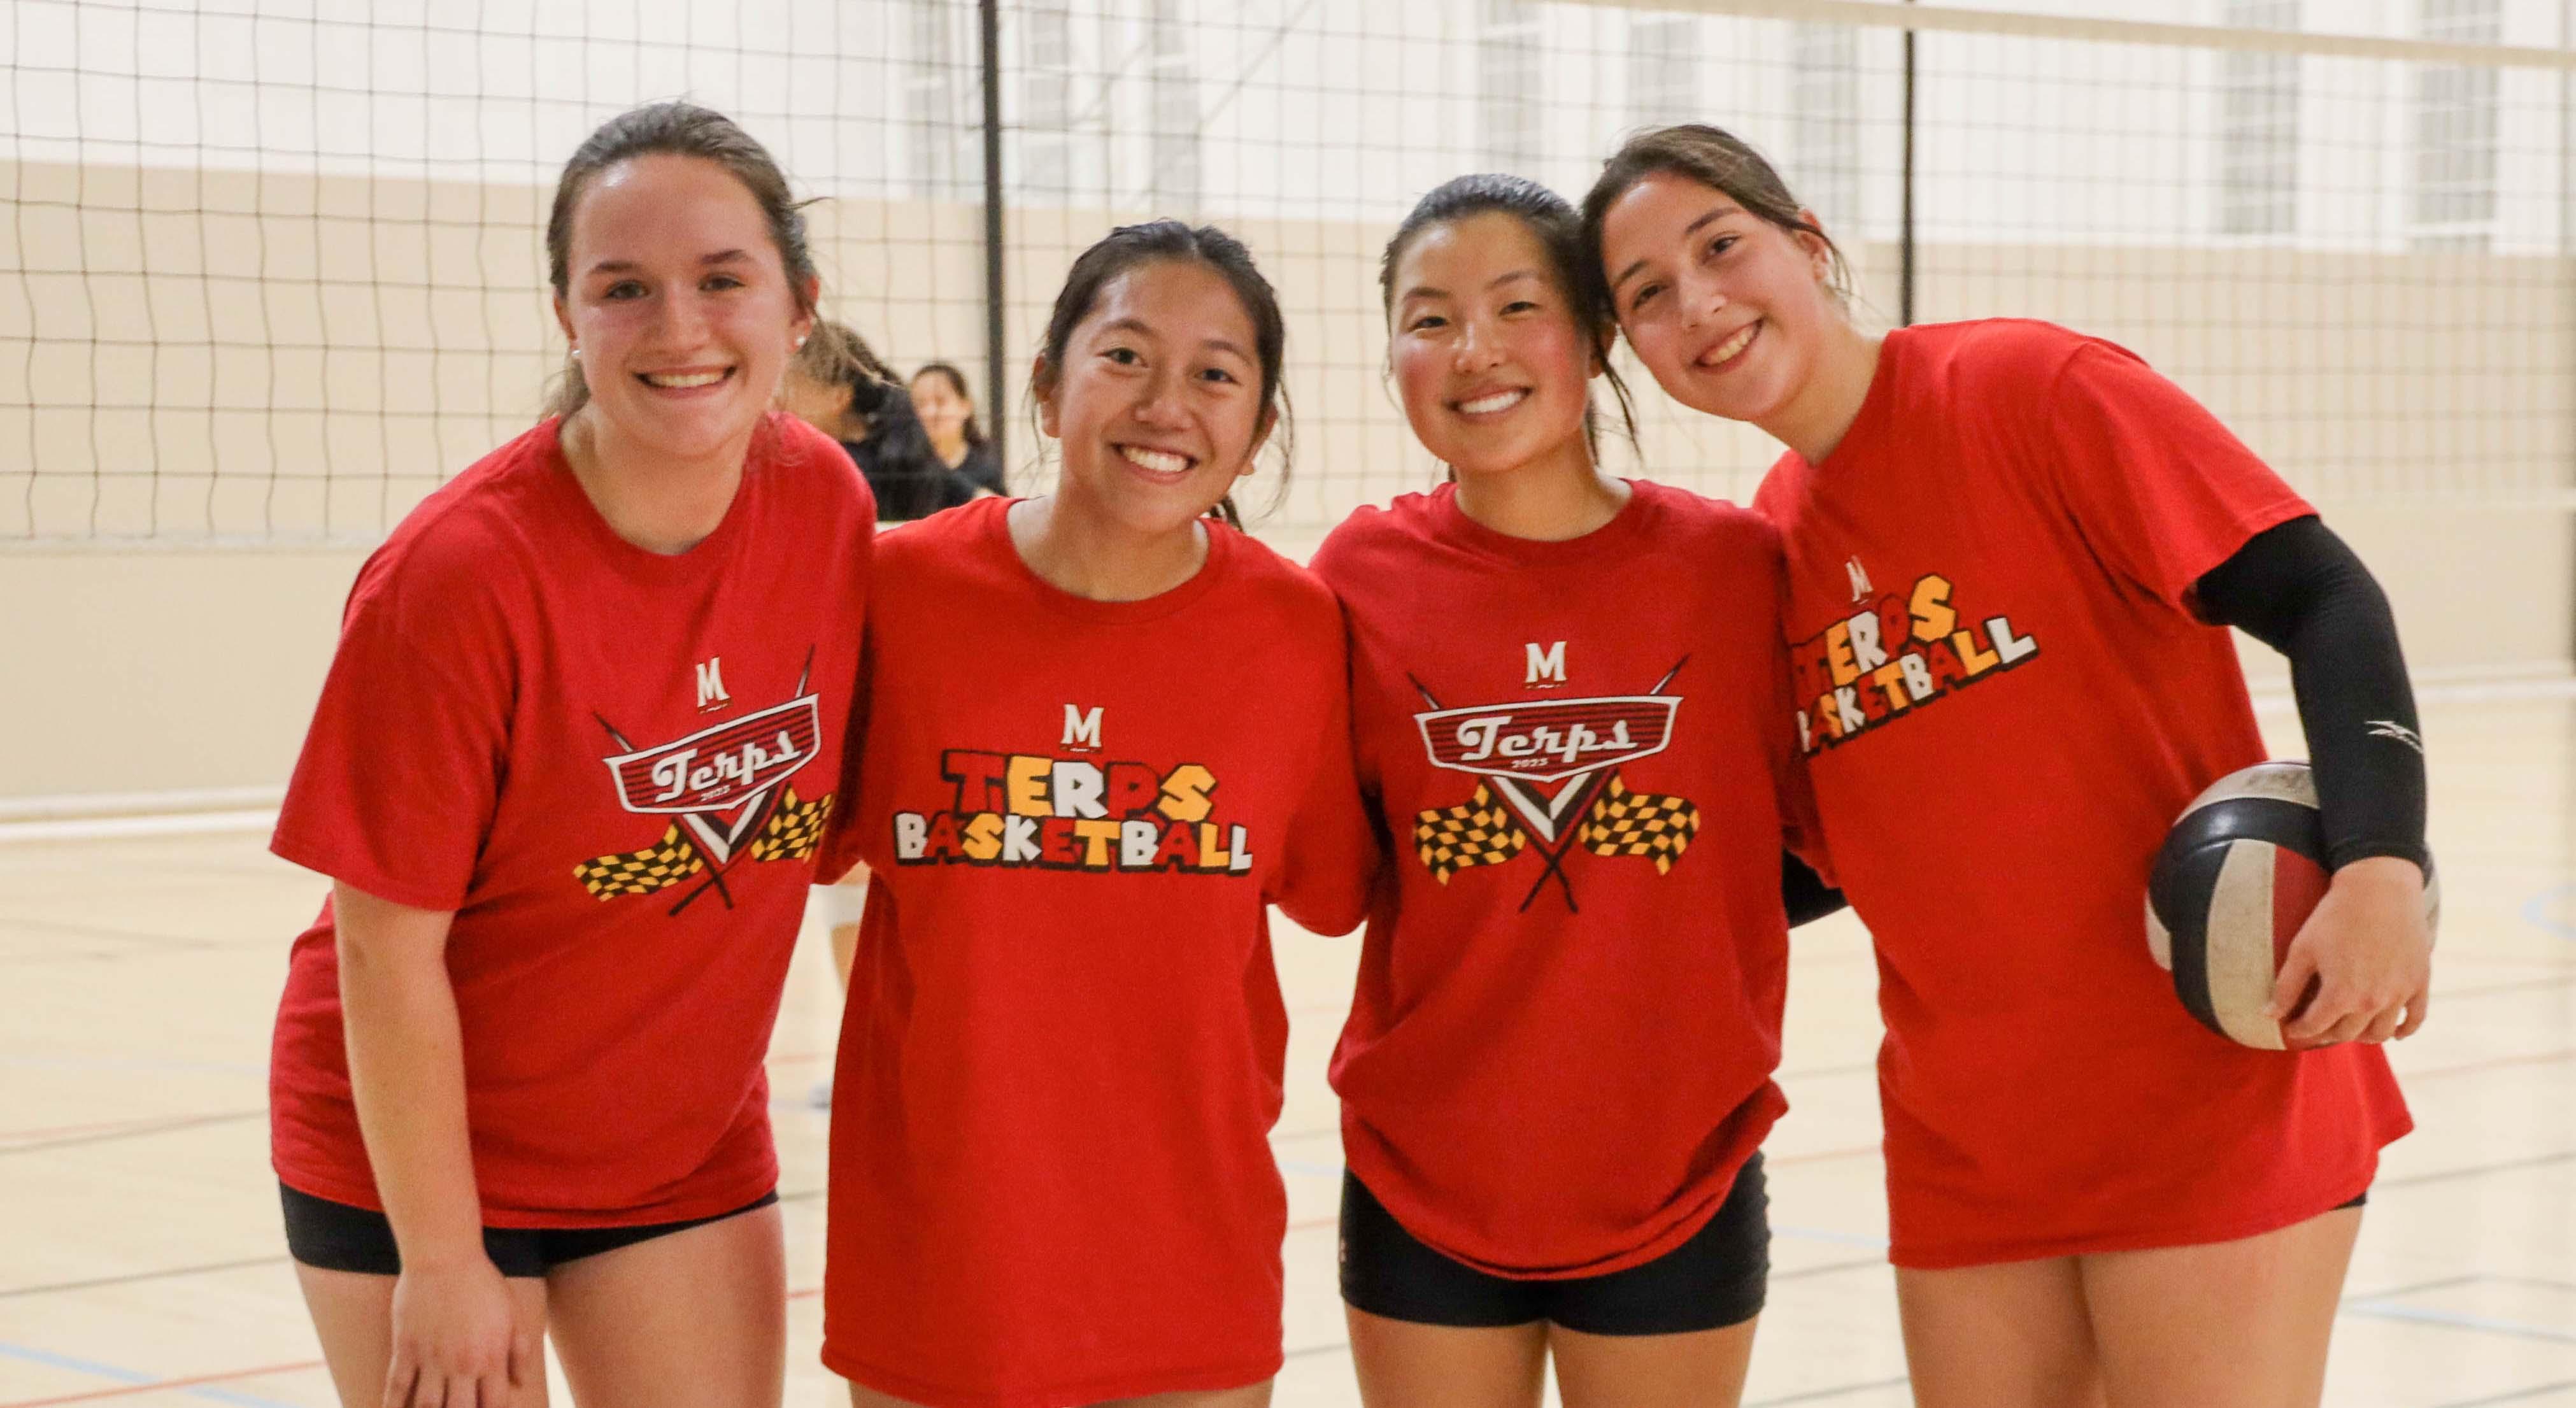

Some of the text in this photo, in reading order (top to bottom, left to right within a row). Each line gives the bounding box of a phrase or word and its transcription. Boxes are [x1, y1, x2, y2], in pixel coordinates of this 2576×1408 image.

[1846, 555, 1874, 602] M
[696, 657, 730, 708] M
[1525, 641, 1567, 682] M
[1060, 704, 1104, 748] M
[1456, 715, 1638, 764] Terps
[651, 730, 802, 803] Terps
[942, 749, 1218, 822] TERPS
[893, 810, 1253, 874] BASKETBALL
